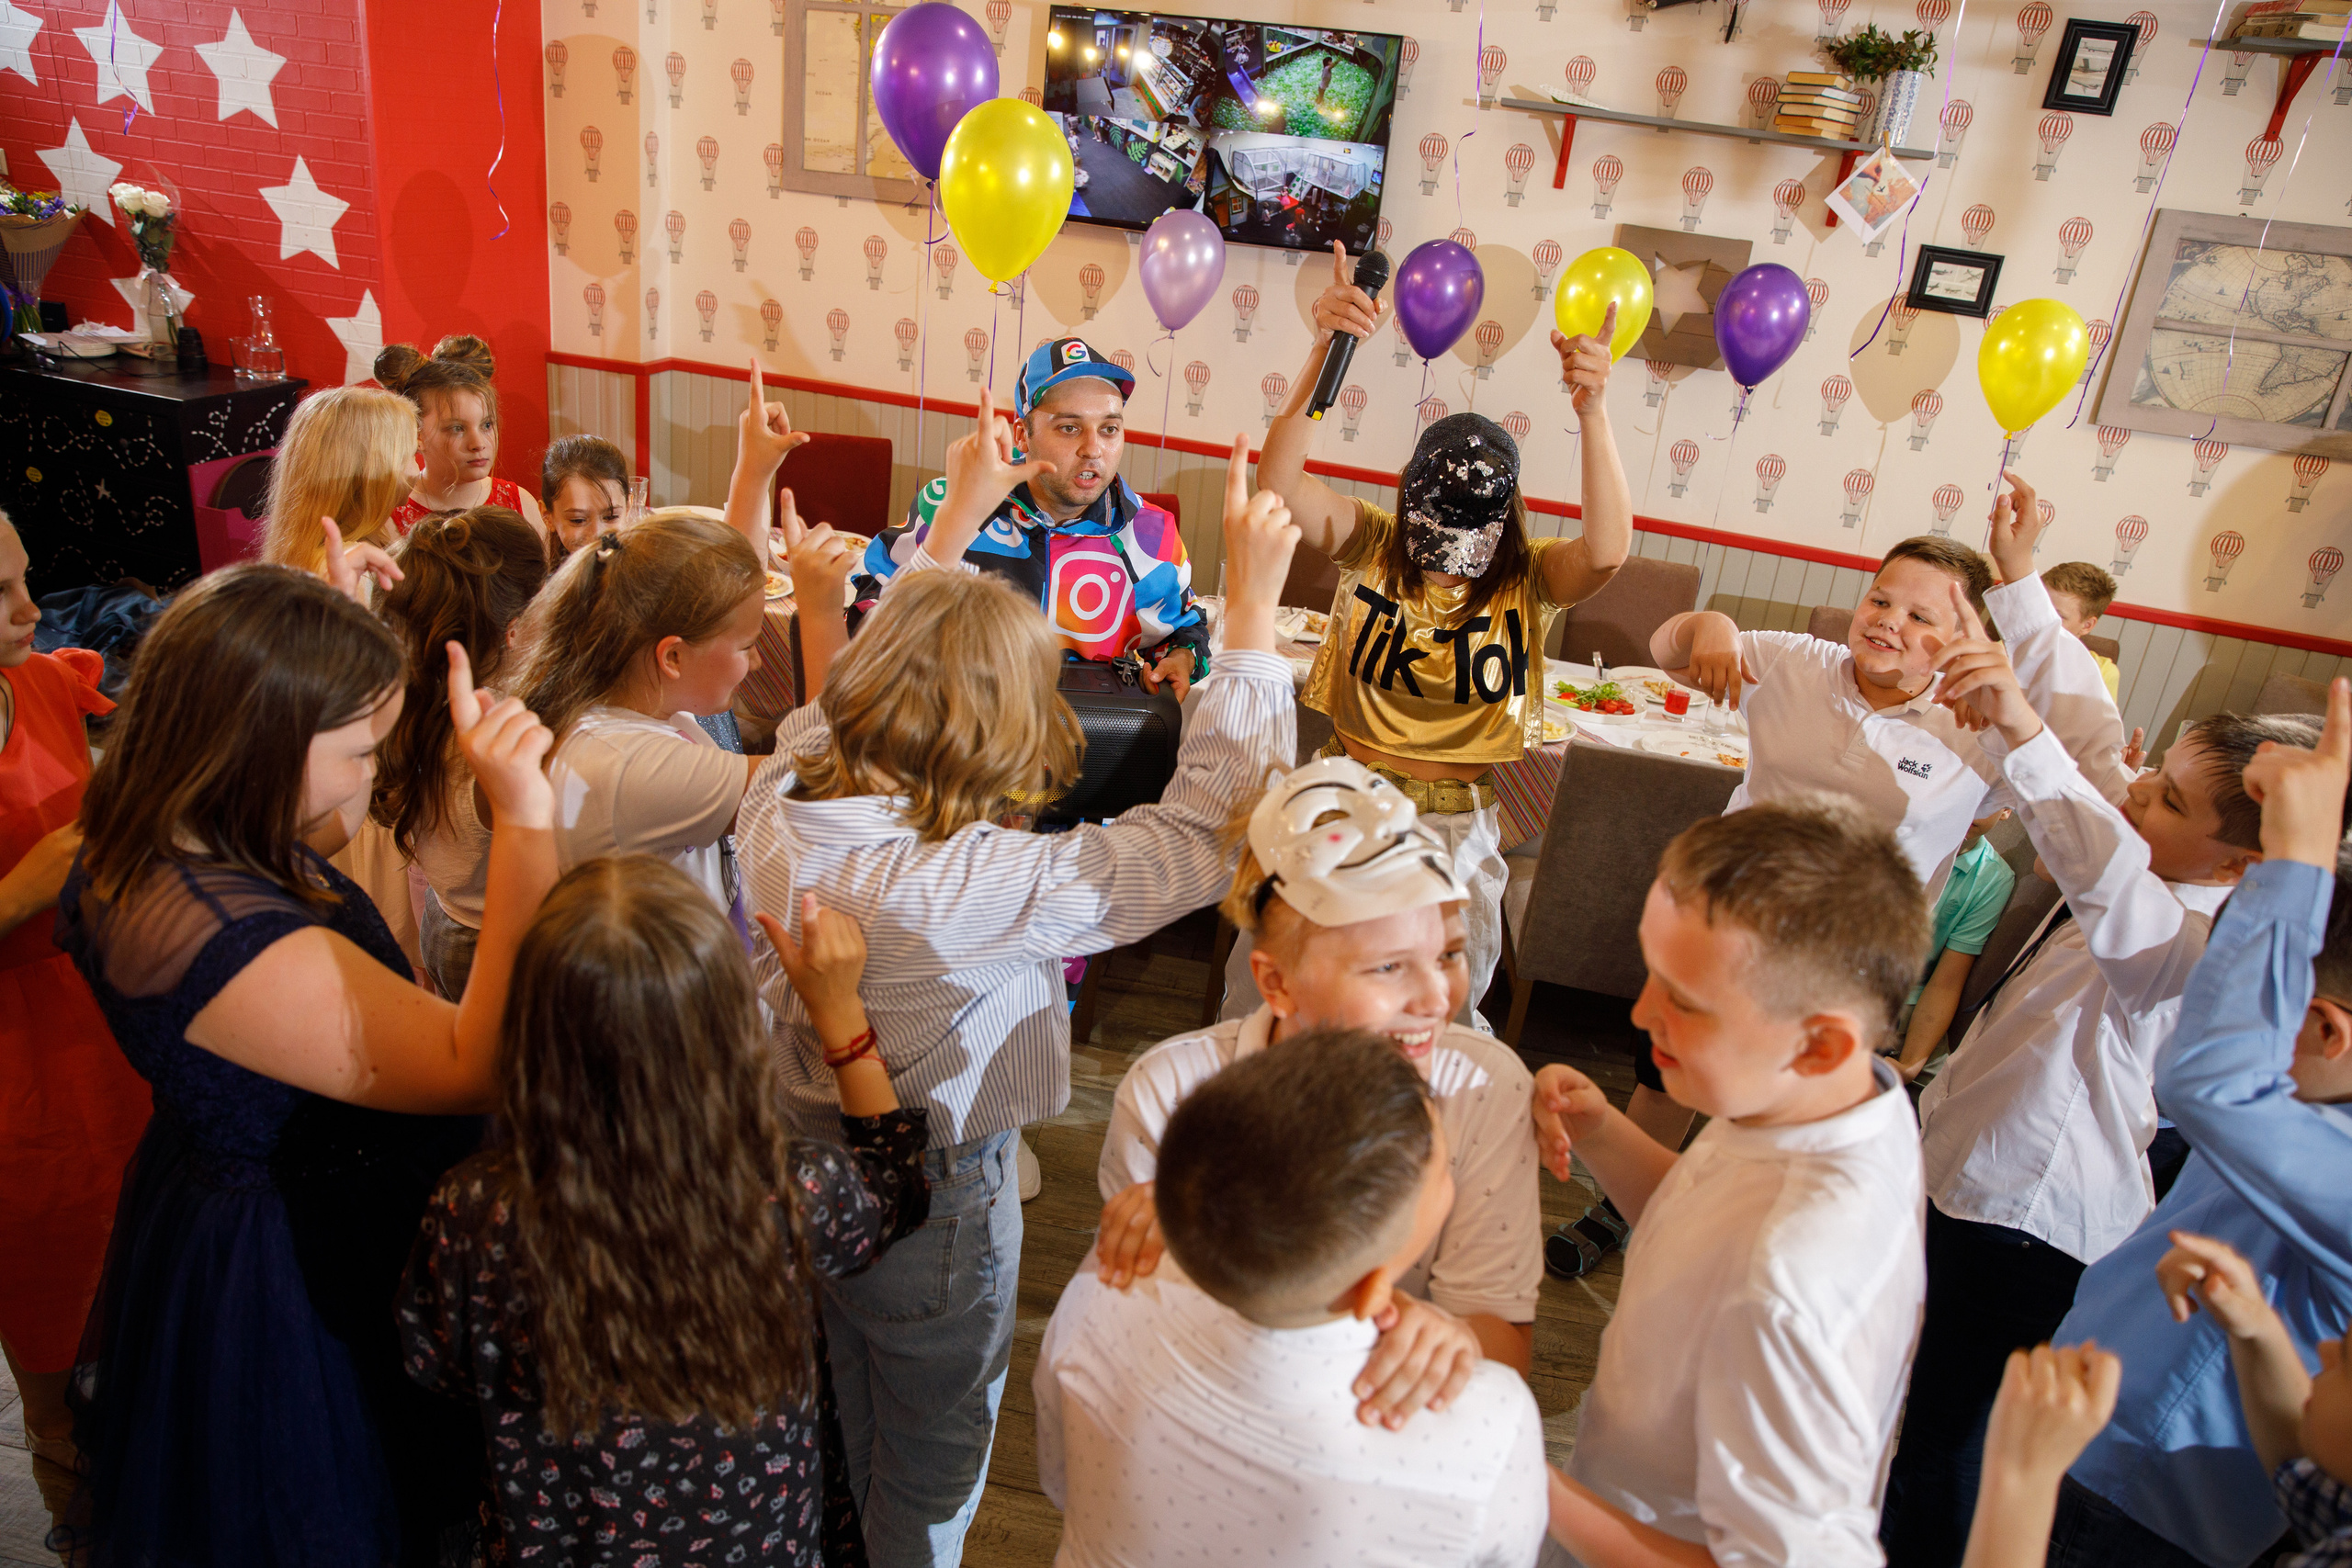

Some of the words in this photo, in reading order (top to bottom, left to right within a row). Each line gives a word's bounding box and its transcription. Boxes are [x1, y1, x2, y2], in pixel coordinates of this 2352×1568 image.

[1066, 344, 1086, 359] G
[1349, 583, 1430, 698] Tik
[1899, 757, 1918, 768] Jack
[1897, 762, 1928, 780] Wolfskin
